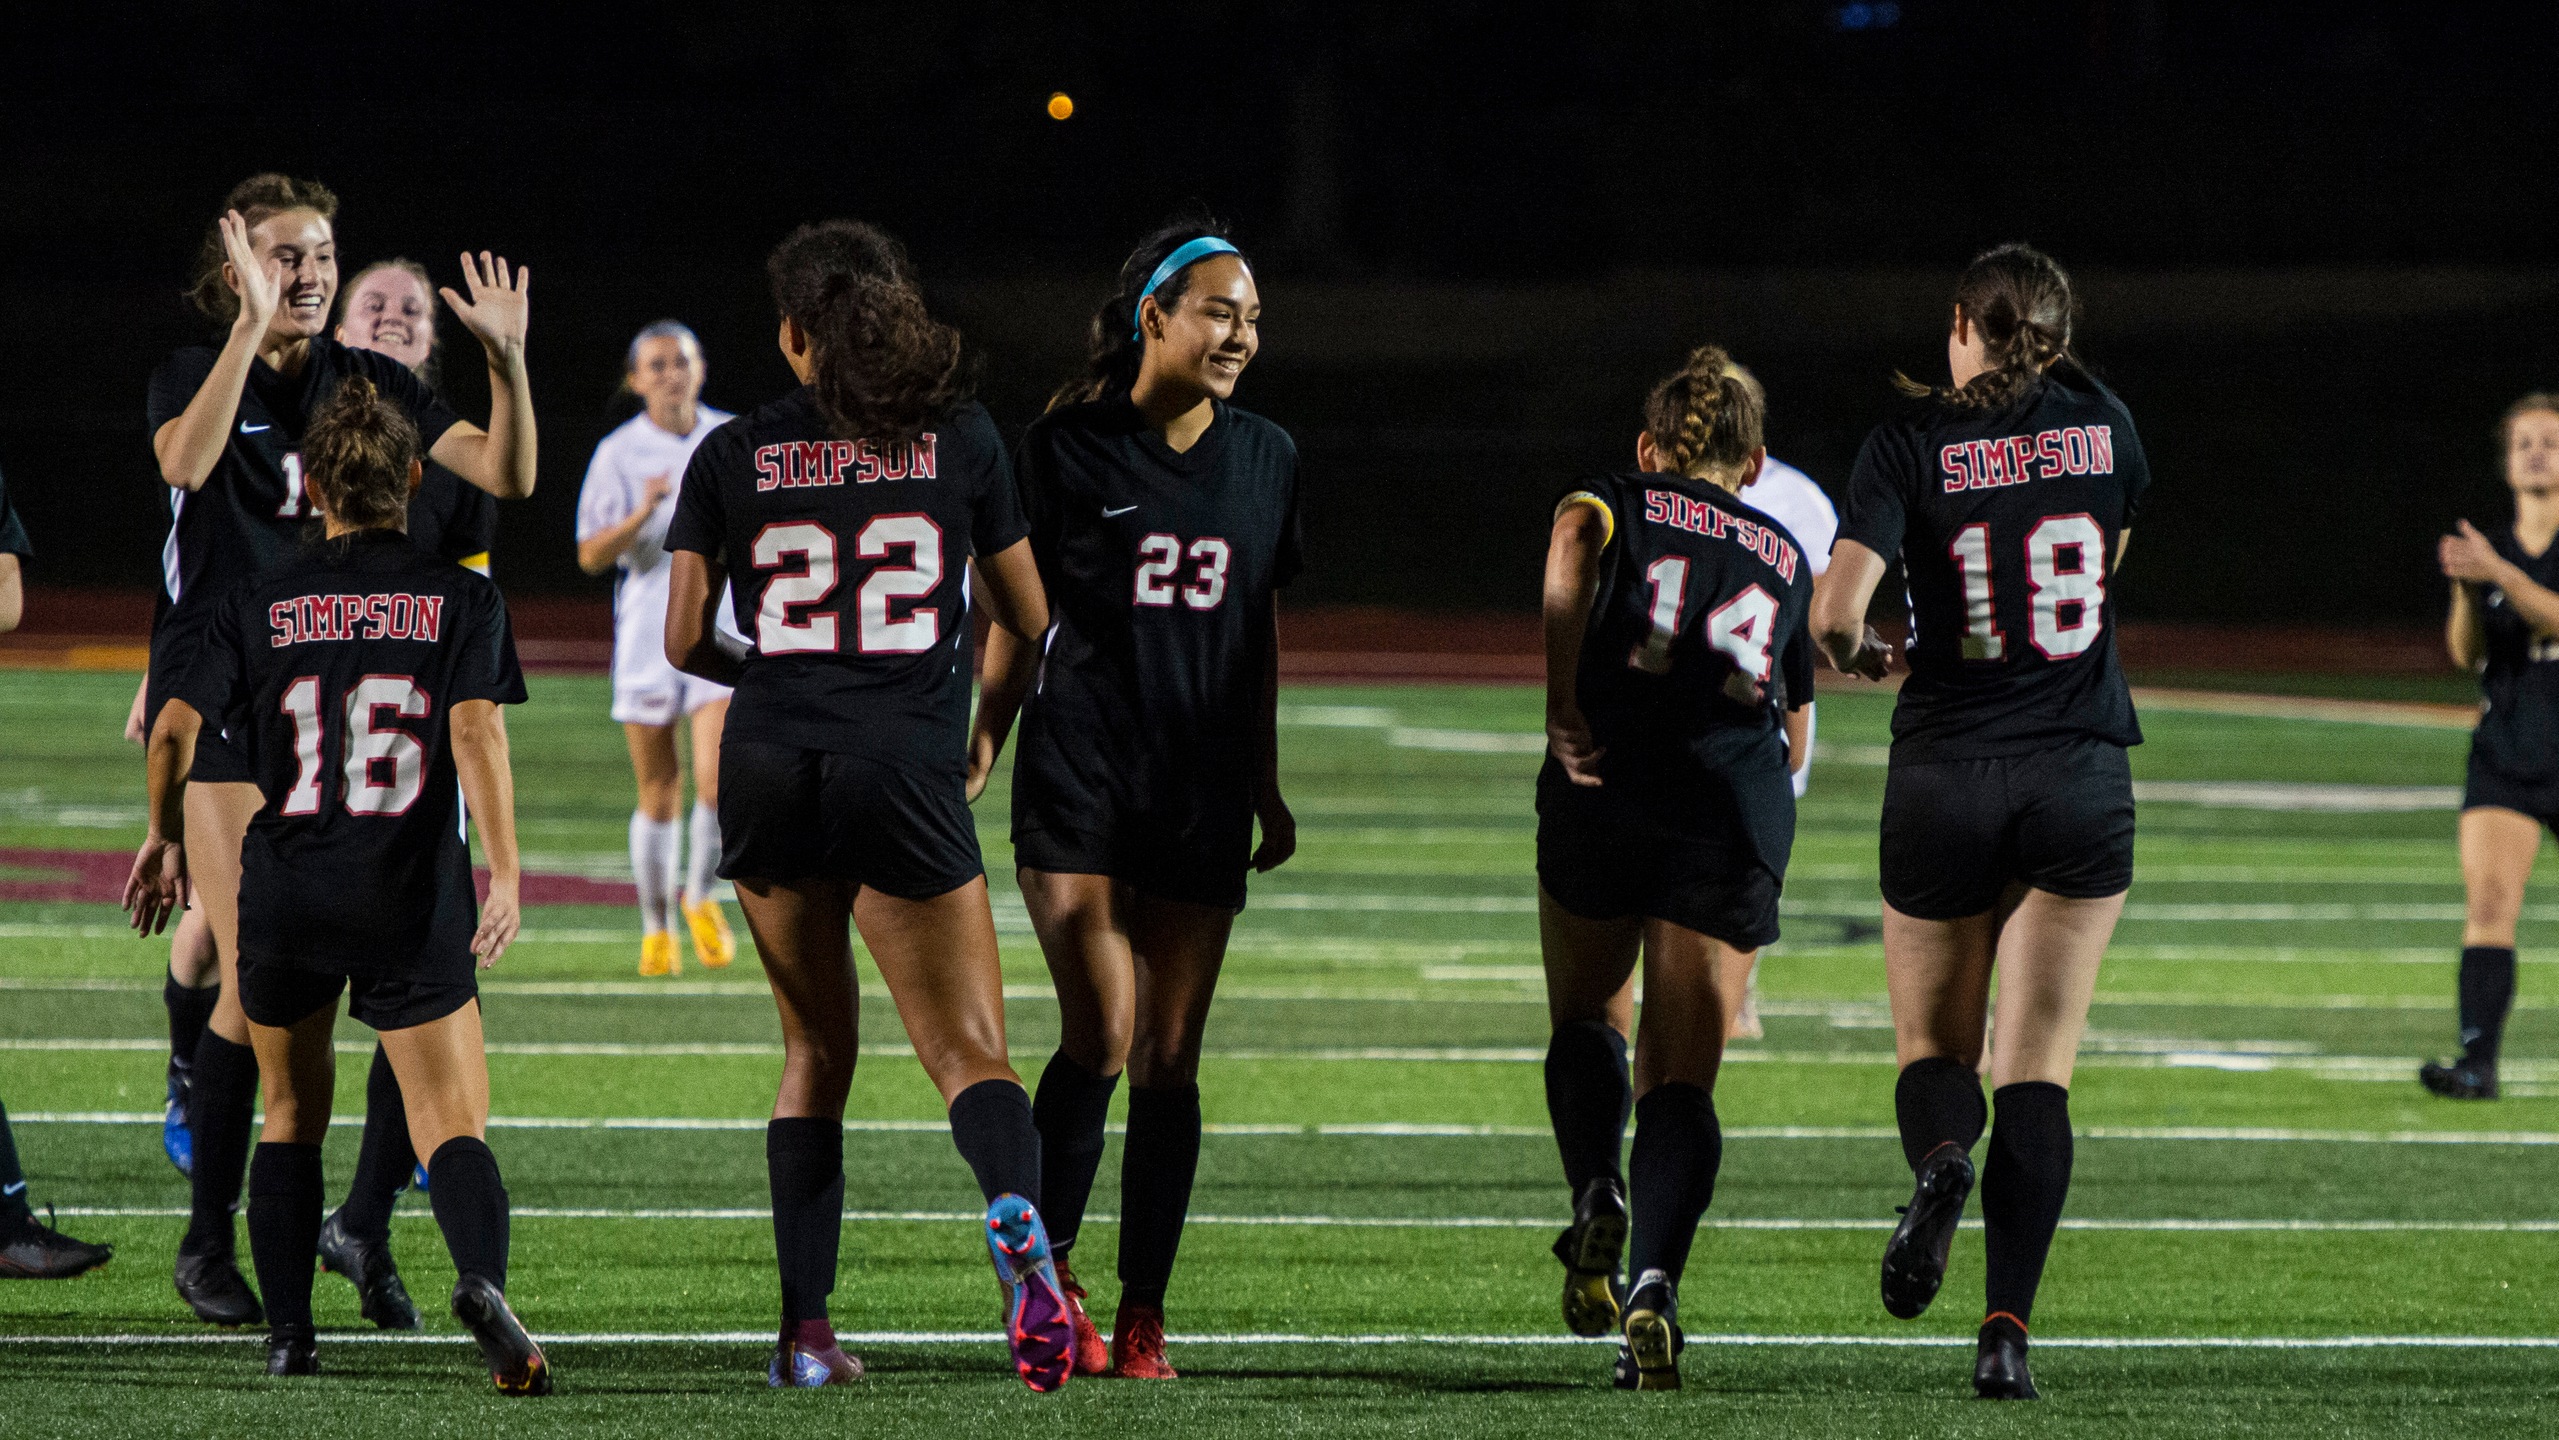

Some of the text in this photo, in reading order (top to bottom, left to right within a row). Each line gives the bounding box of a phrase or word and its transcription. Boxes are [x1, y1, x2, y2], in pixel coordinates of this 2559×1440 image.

[276, 452, 325, 518] 1
[754, 432, 937, 491] SIMPSON
[1940, 425, 2114, 493] SIMPSON
[1132, 531, 1233, 612] 23
[1645, 489, 1799, 586] SIMPSON
[269, 593, 444, 648] SIMPSON
[751, 511, 945, 657] 22
[1948, 512, 2106, 662] 18
[1627, 554, 1781, 706] 14
[279, 673, 432, 817] 16
